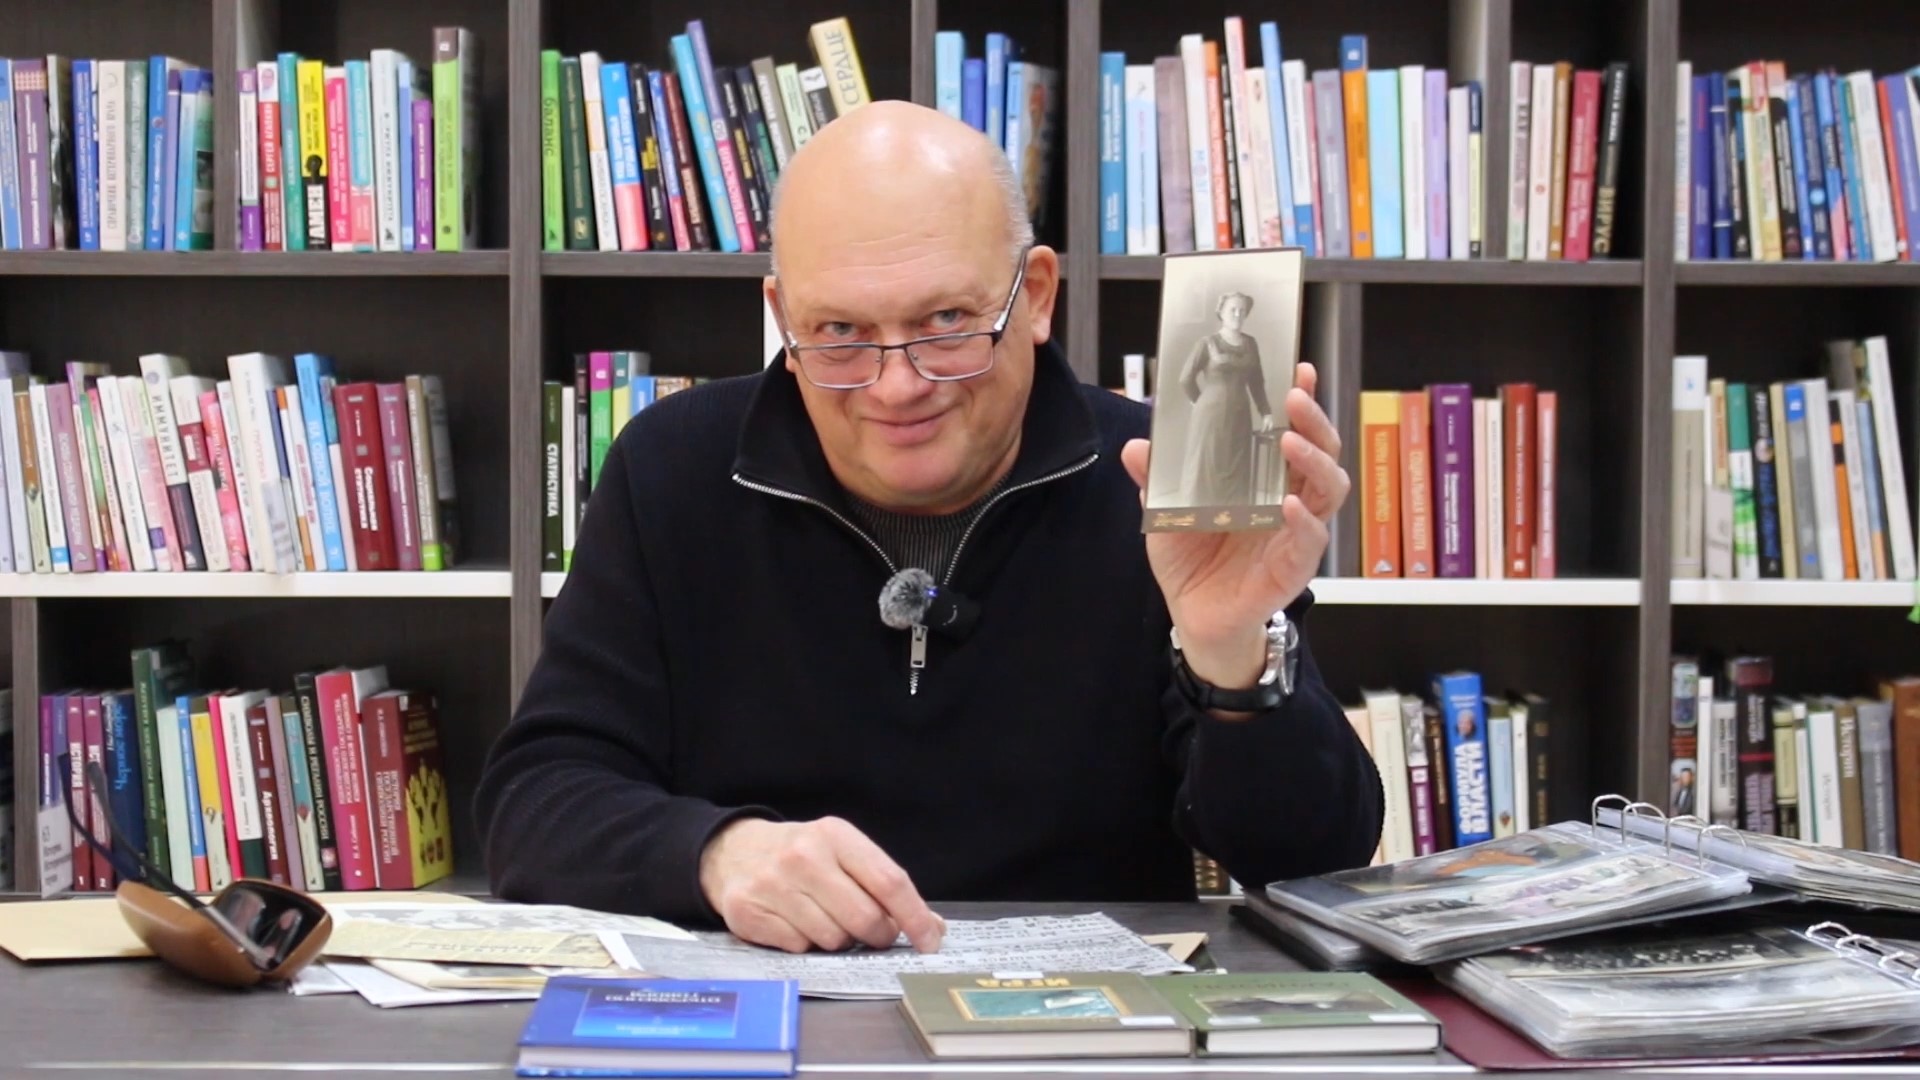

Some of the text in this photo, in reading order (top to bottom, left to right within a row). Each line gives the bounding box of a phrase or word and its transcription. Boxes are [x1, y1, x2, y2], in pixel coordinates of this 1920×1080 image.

[823, 26, 862, 108] СЕРДЦЕ
[542, 96, 558, 157] баланс
[1592, 185, 1616, 254] ВИРУС
[150, 393, 179, 478] ИММУНИТЕТ
[546, 442, 558, 517] СТАТИСТИКА
[68, 741, 84, 788] ИСТОРИЯ
[1837, 717, 1859, 779] История
[1453, 742, 1472, 834] ФОРМУЛА
[1468, 741, 1489, 834] ВЛАСТИ
[260, 789, 279, 861] Археология
[976, 977, 1071, 988] ИГРА
